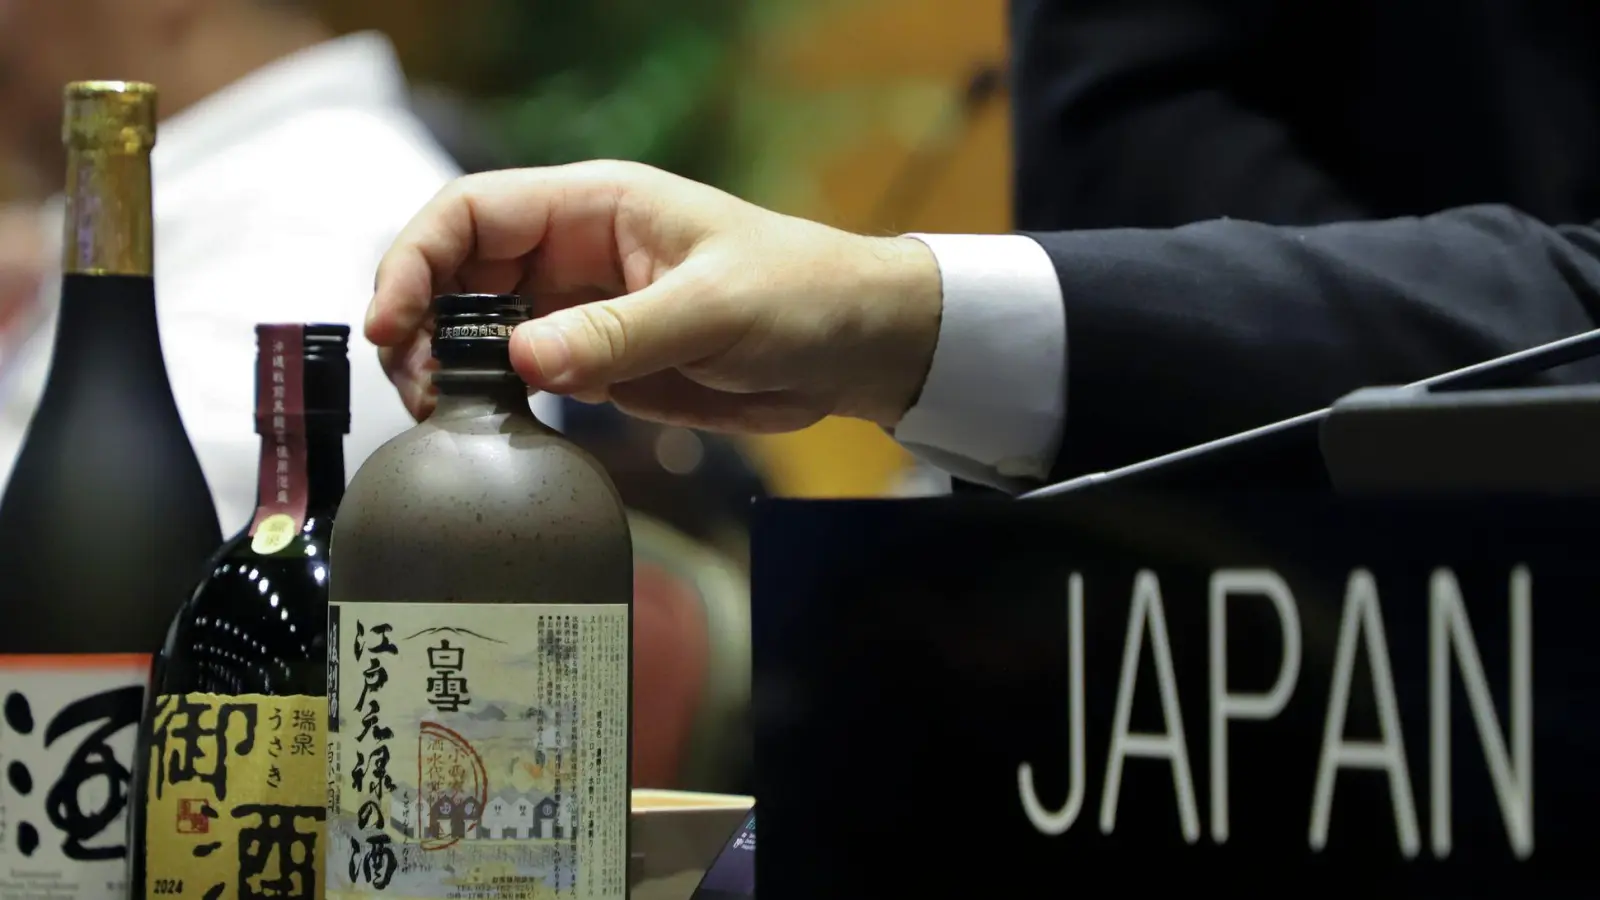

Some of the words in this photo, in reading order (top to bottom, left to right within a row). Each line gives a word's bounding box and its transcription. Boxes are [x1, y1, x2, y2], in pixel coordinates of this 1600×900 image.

[291, 709, 316, 756] 瑞泉
[427, 639, 472, 712] 白雪
[1018, 565, 1534, 860] JAPAN
[4, 683, 146, 862] 酒
[348, 619, 399, 890] 江戸元禄の酒
[154, 879, 183, 895] 2024
